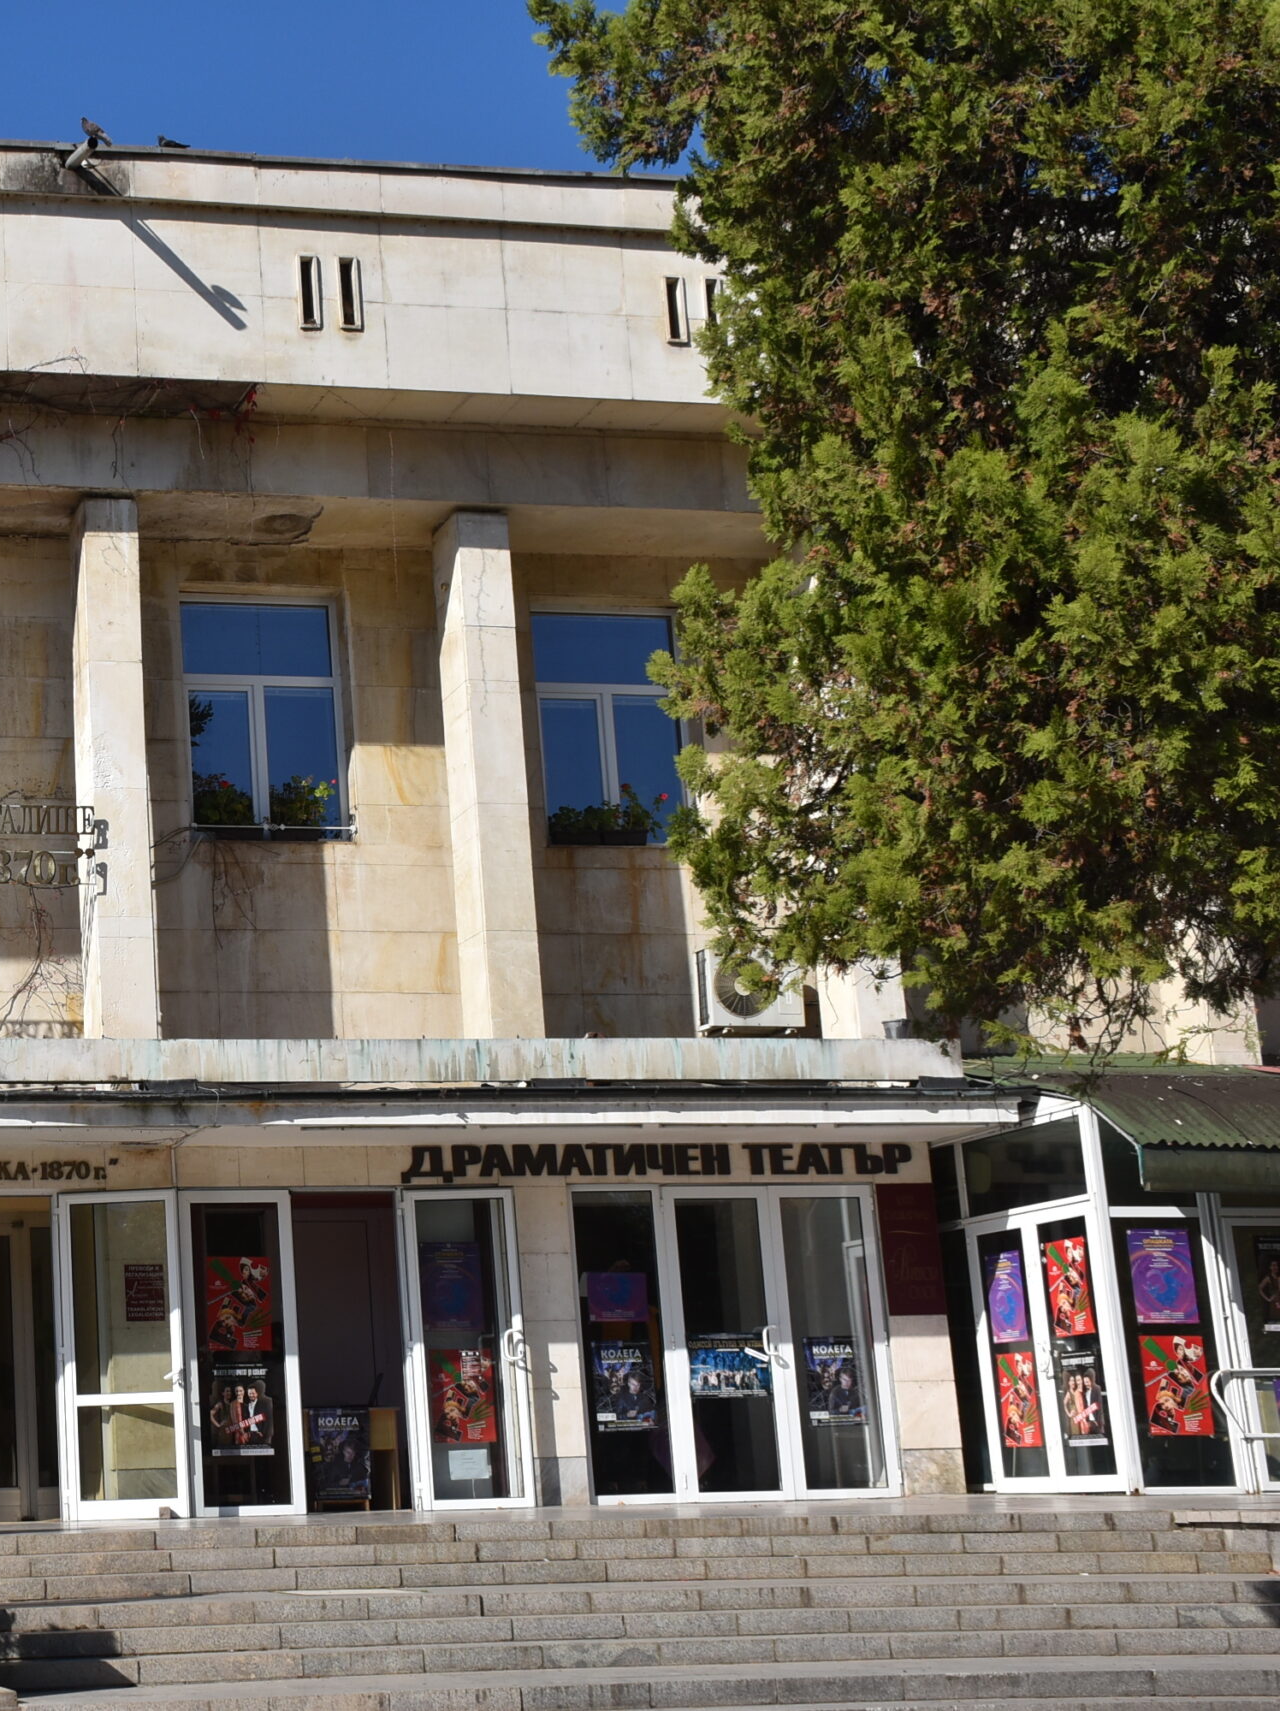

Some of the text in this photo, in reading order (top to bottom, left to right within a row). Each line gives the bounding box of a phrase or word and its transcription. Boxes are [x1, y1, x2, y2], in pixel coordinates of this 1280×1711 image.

[401, 1143, 912, 1184] ДРАМАТИЧЕН ТЕАТЪР
[601, 1348, 642, 1359] КОЛЕГА
[812, 1343, 853, 1354] КОЛЕГА
[317, 1416, 360, 1427] КОЛЕГА
